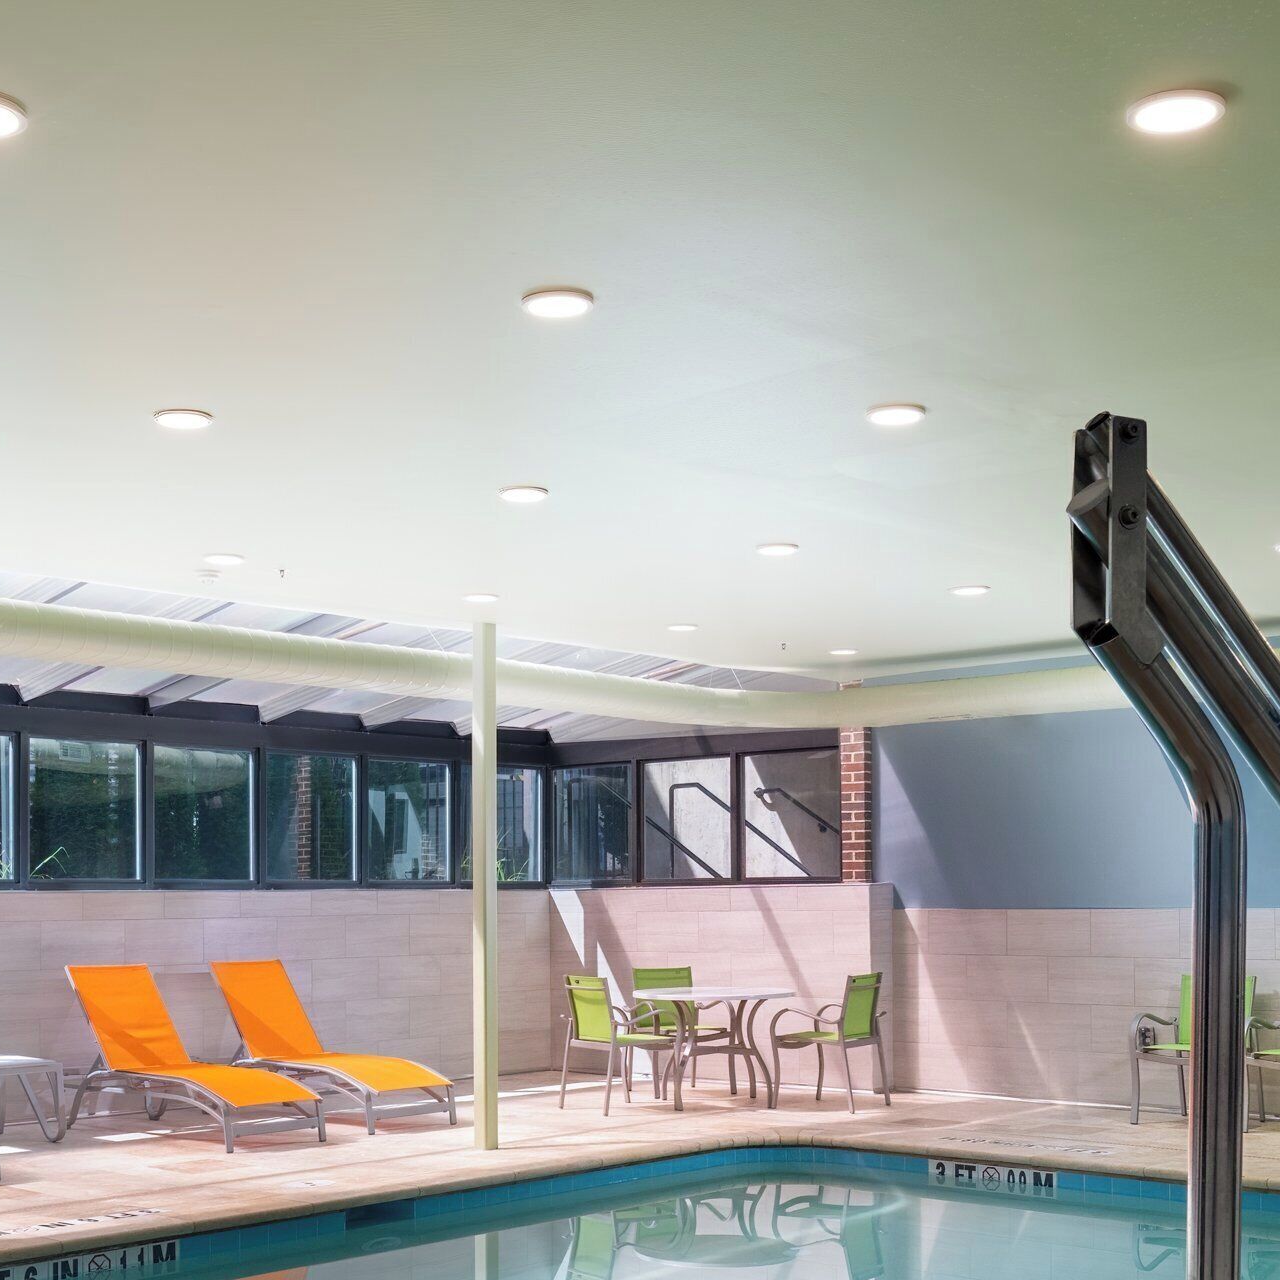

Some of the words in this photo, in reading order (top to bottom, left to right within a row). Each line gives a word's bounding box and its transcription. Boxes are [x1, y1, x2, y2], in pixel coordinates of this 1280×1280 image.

[935, 1161, 947, 1176] 3
[954, 1163, 977, 1180] FT
[1032, 1171, 1054, 1188] M
[52, 1257, 79, 1280] IN
[152, 1241, 177, 1265] M
